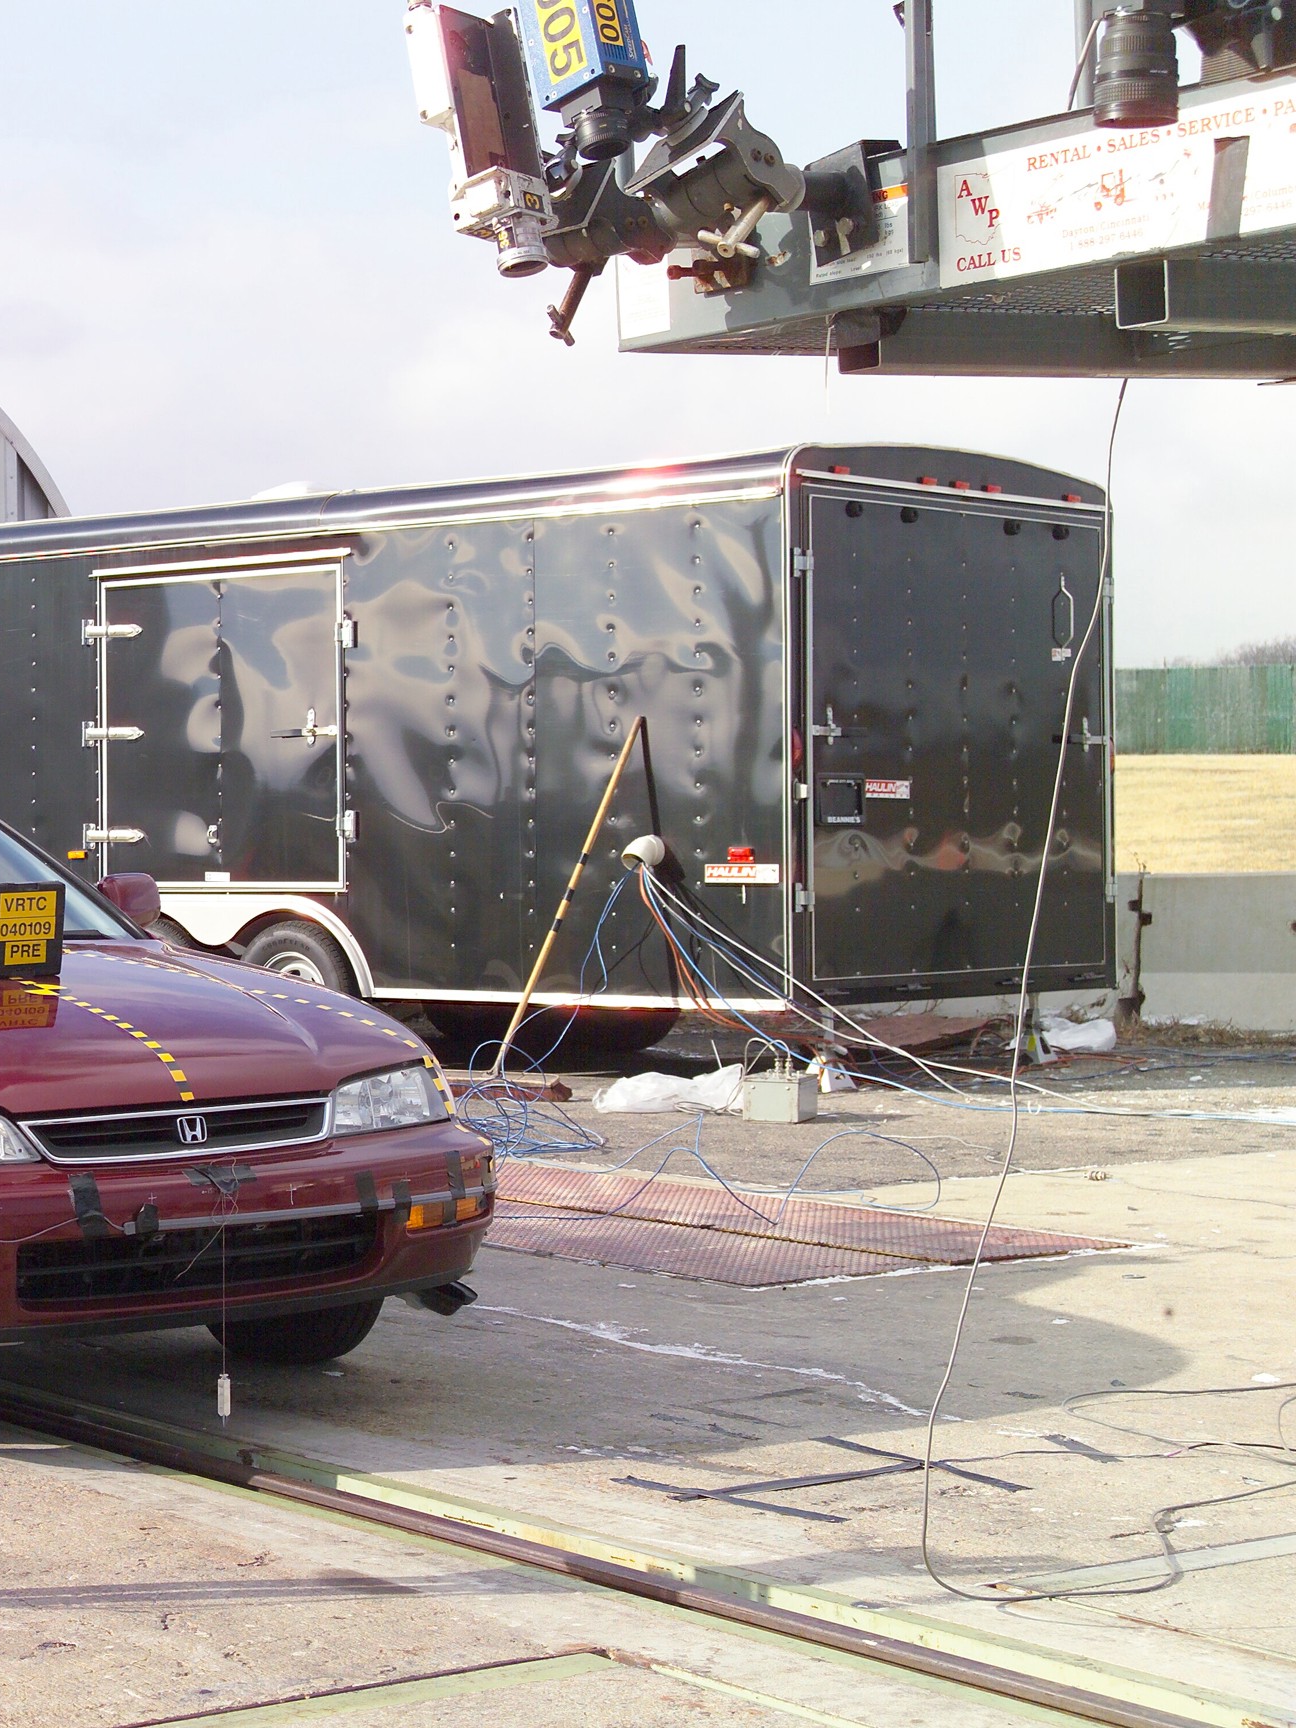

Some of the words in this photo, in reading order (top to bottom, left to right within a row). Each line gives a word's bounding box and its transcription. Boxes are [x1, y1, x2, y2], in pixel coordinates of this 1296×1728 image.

[537, 0, 584, 76] 05
[1026, 145, 1091, 172] RENTAL
[1106, 129, 1161, 155] SALES
[1176, 107, 1256, 138] SERVICE
[956, 250, 996, 272] CALL
[1000, 246, 1023, 264] US
[706, 866, 757, 878] HAULIN
[4, 896, 48, 912] VRTC
[0, 921, 52, 937] 040109
[10, 943, 42, 958] PRE
